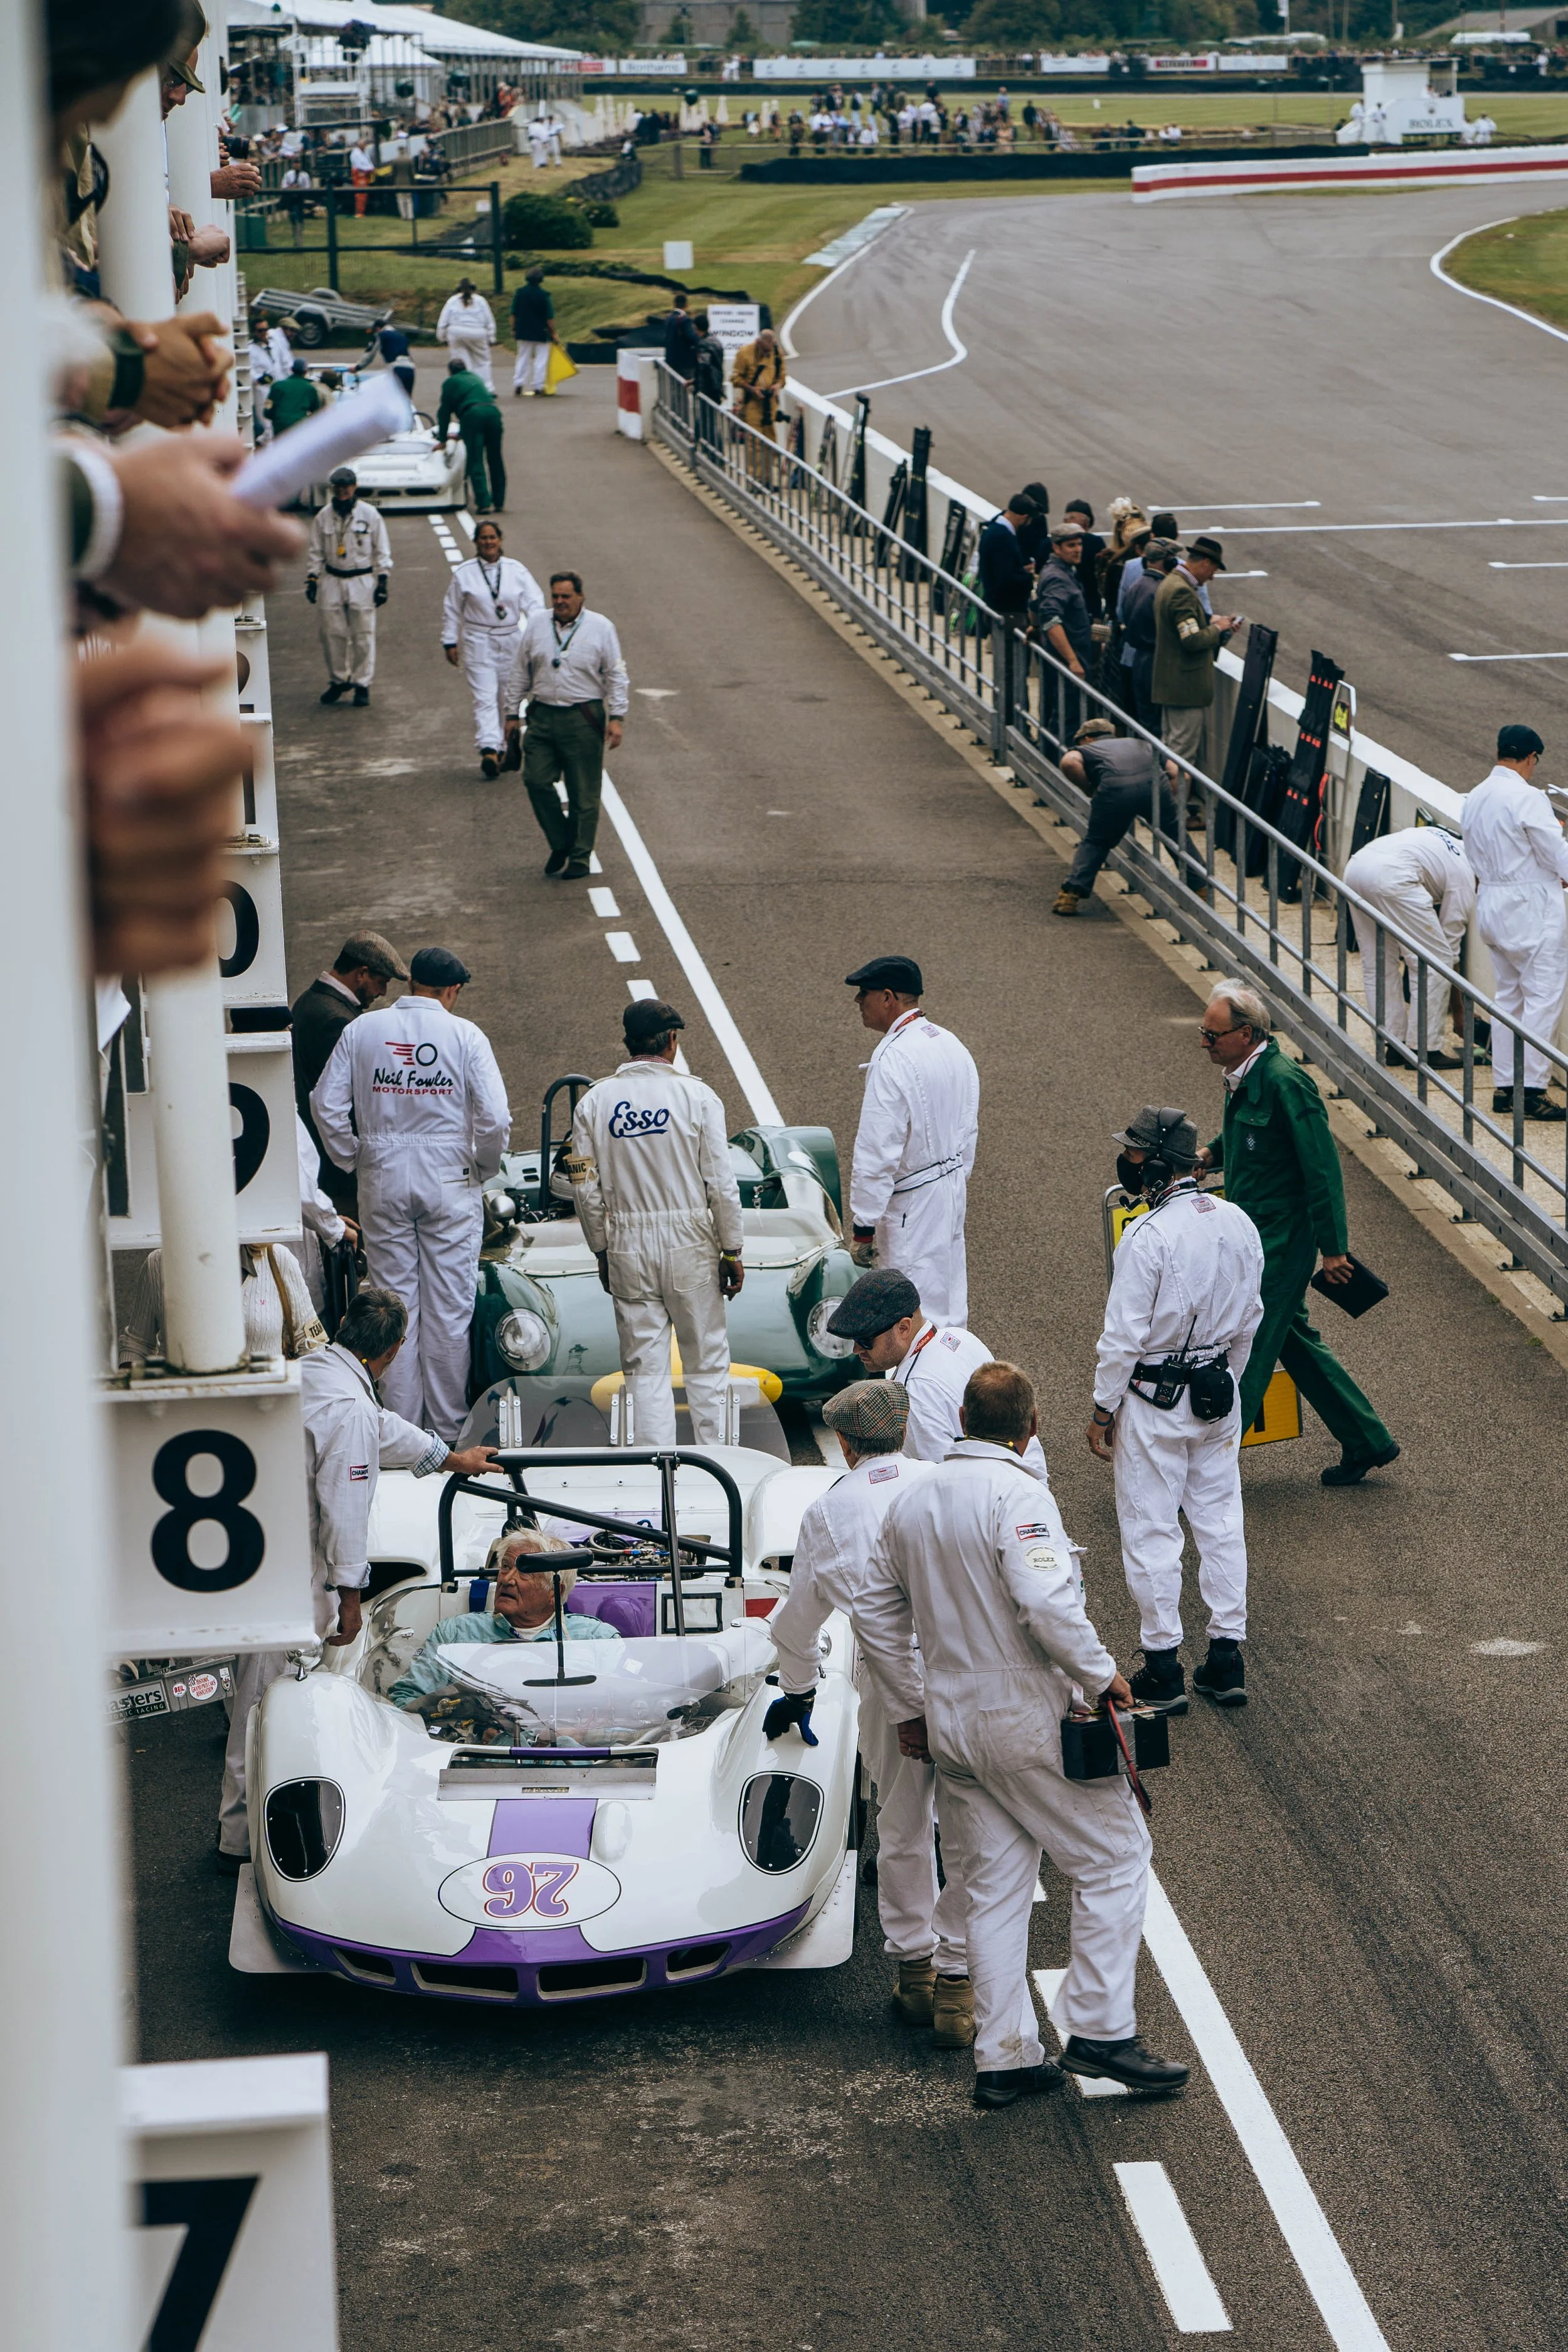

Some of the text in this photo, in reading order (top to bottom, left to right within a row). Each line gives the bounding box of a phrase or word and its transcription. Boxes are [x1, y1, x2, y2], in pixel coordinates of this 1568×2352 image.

[372, 1086, 453, 1095] MOTORSPORT
[373, 1067, 453, 1088] Neil Fowler
[608, 1101, 670, 1138] Esso
[151, 1429, 265, 1592] 8
[1019, 1527, 1047, 1536] CHAMPION
[482, 1862, 579, 1918] 97
